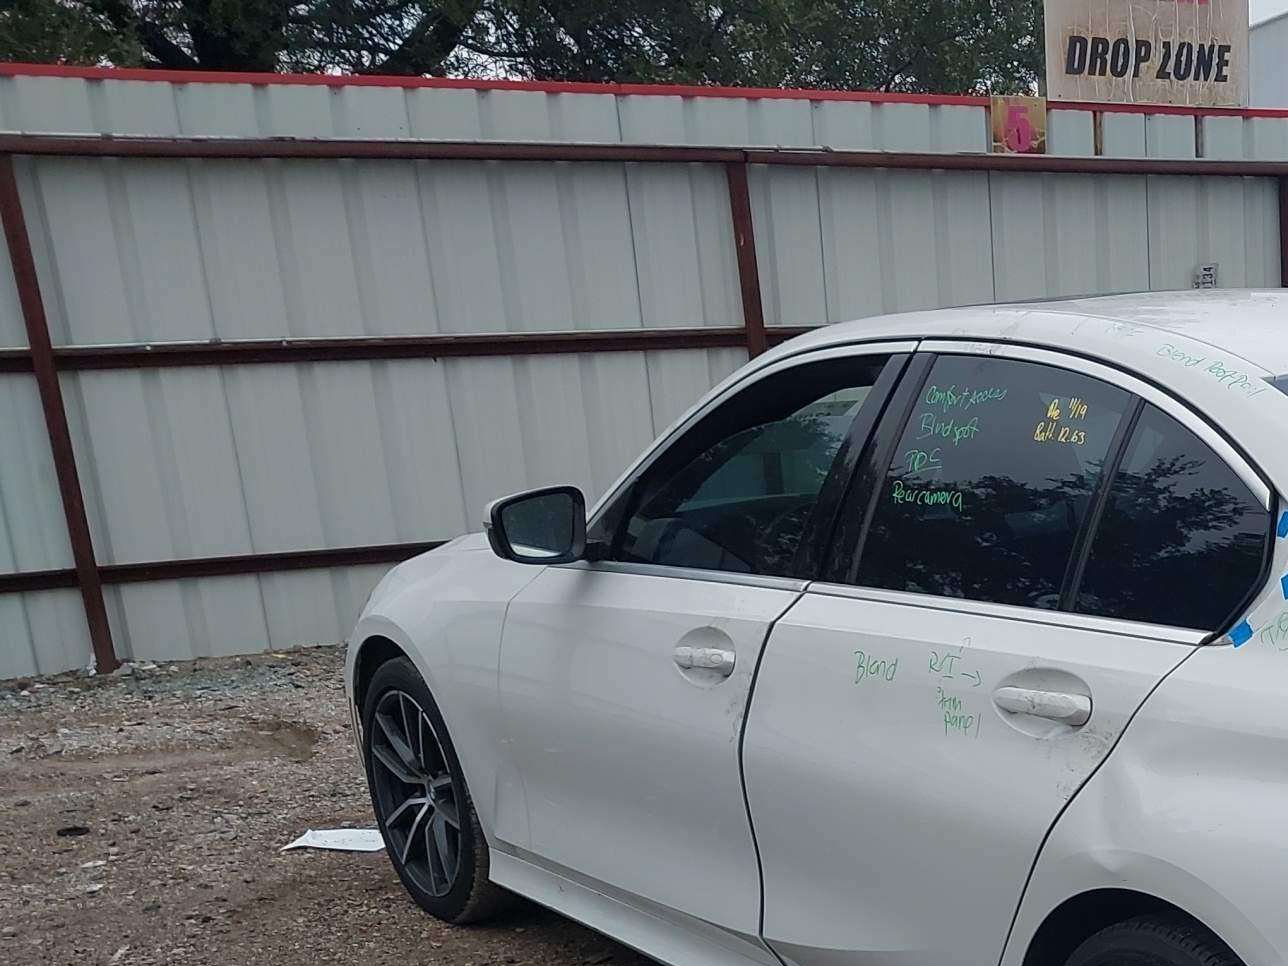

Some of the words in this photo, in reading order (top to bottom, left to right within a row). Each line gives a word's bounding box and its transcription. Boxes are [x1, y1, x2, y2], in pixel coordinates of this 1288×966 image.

[1065, 35, 1151, 78] DROP
[1156, 40, 1232, 82] ZONE
[1004, 105, 1032, 152] 5
